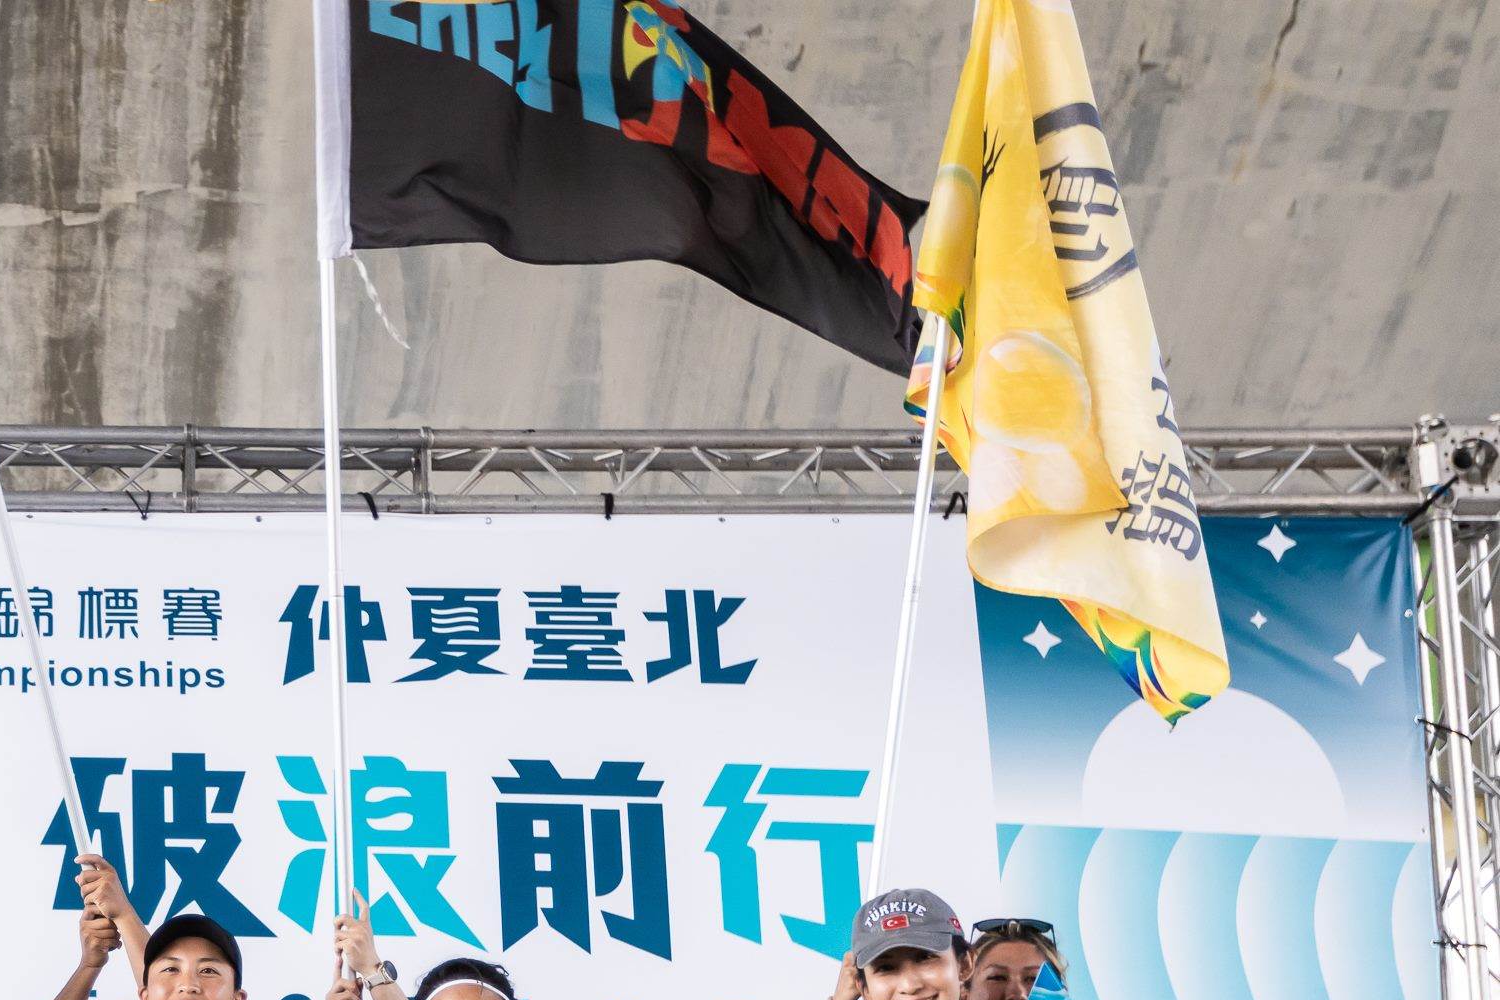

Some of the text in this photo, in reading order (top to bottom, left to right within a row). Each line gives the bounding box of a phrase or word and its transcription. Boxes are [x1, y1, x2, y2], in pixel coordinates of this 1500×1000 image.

[278, 584, 759, 687] 仲夏臺北
[40, 752, 877, 962] 破浪前行
[864, 898, 927, 928] TÜRKİYE
